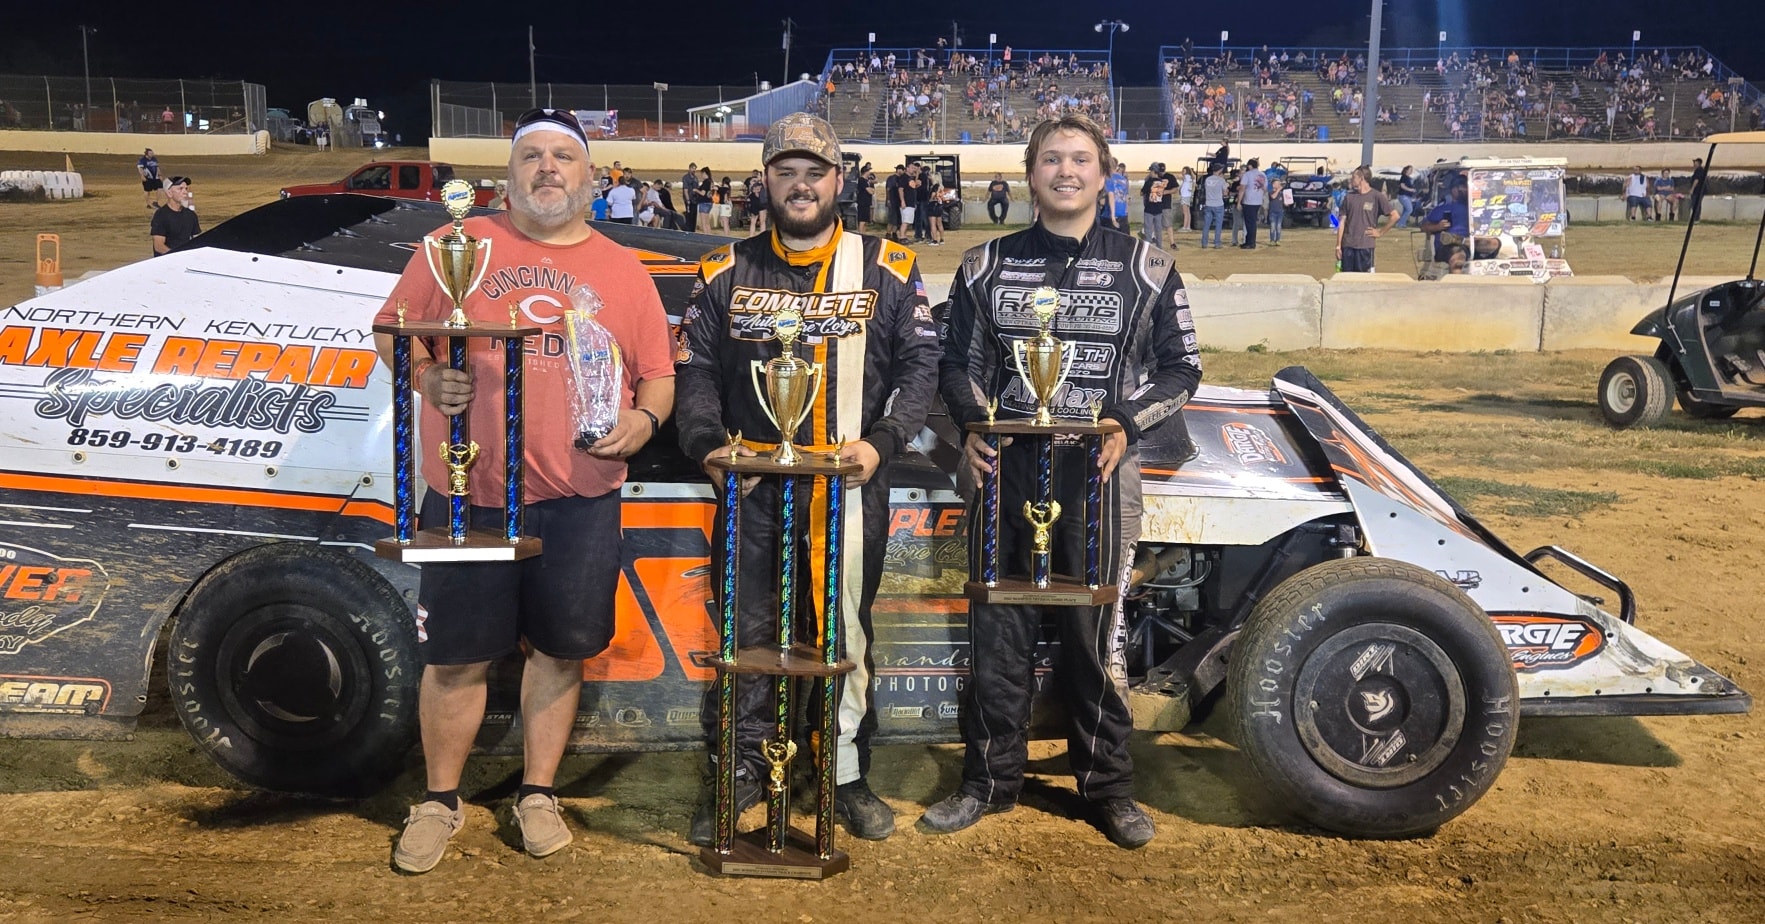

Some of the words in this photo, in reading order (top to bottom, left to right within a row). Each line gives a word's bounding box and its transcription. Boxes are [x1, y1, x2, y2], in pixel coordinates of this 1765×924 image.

[480, 266, 577, 300] CINCINN
[730, 290, 873, 317] COMPLETE
[998, 301, 1117, 318] RAING
[3, 306, 186, 331] NORTHERN
[204, 319, 374, 343] KENTUCKY
[0, 325, 151, 373] AXLE
[153, 335, 378, 389] REPAIR
[35, 367, 337, 434] Specialists
[67, 428, 283, 459] 859-913-4189
[1512, 651, 1572, 663] Engines
